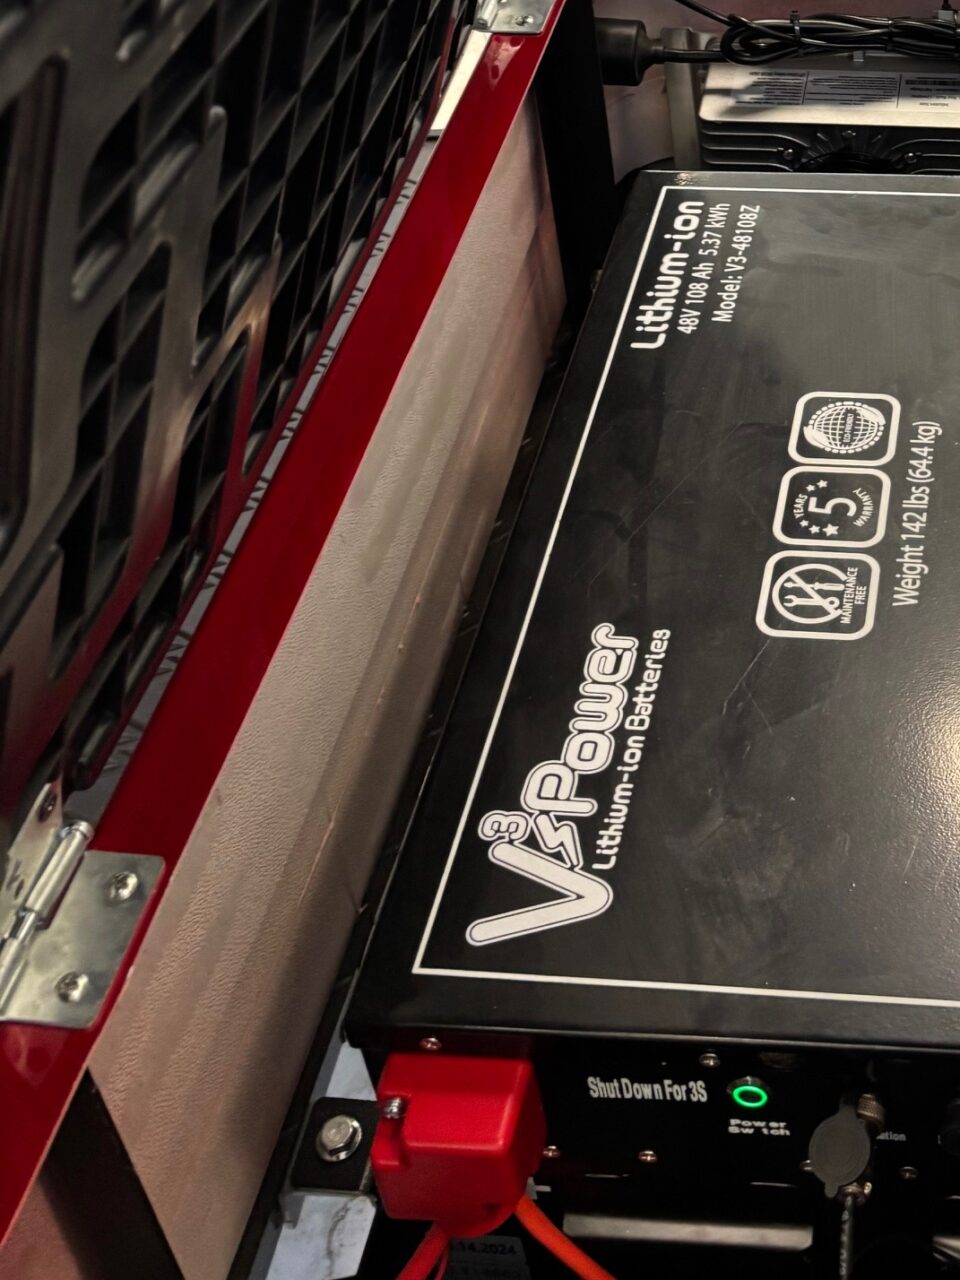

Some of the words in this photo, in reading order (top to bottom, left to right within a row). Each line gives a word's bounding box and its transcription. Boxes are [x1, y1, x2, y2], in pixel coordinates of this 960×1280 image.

[705, 203, 730, 228] kWh
[699, 231, 721, 256] 5.37
[724, 205, 760, 271] V3-48108Z
[630, 201, 705, 349] Lithium-ion
[692, 263, 715, 279] Ah
[685, 283, 711, 304] 108
[711, 276, 743, 322] Model:
[677, 309, 701, 334] 48V
[911, 420, 942, 444] kg)
[906, 446, 935, 482] (64.4
[794, 493, 808, 518] YEARS
[808, 496, 858, 517] 5
[852, 487, 874, 528] WARRANTY
[903, 487, 929, 508] lbs
[902, 512, 927, 541] 142
[892, 545, 929, 606] Weight
[841, 567, 858, 624] MAINTENANCE
[856, 586, 868, 605] FREE
[592, 735, 646, 870] Lithium-ion
[624, 628, 672, 731] Batteries
[587, 1076, 622, 1099] Shut
[663, 1079, 687, 1101] For
[690, 1080, 708, 1102] 3S
[728, 1126, 791, 1136] Swtch
